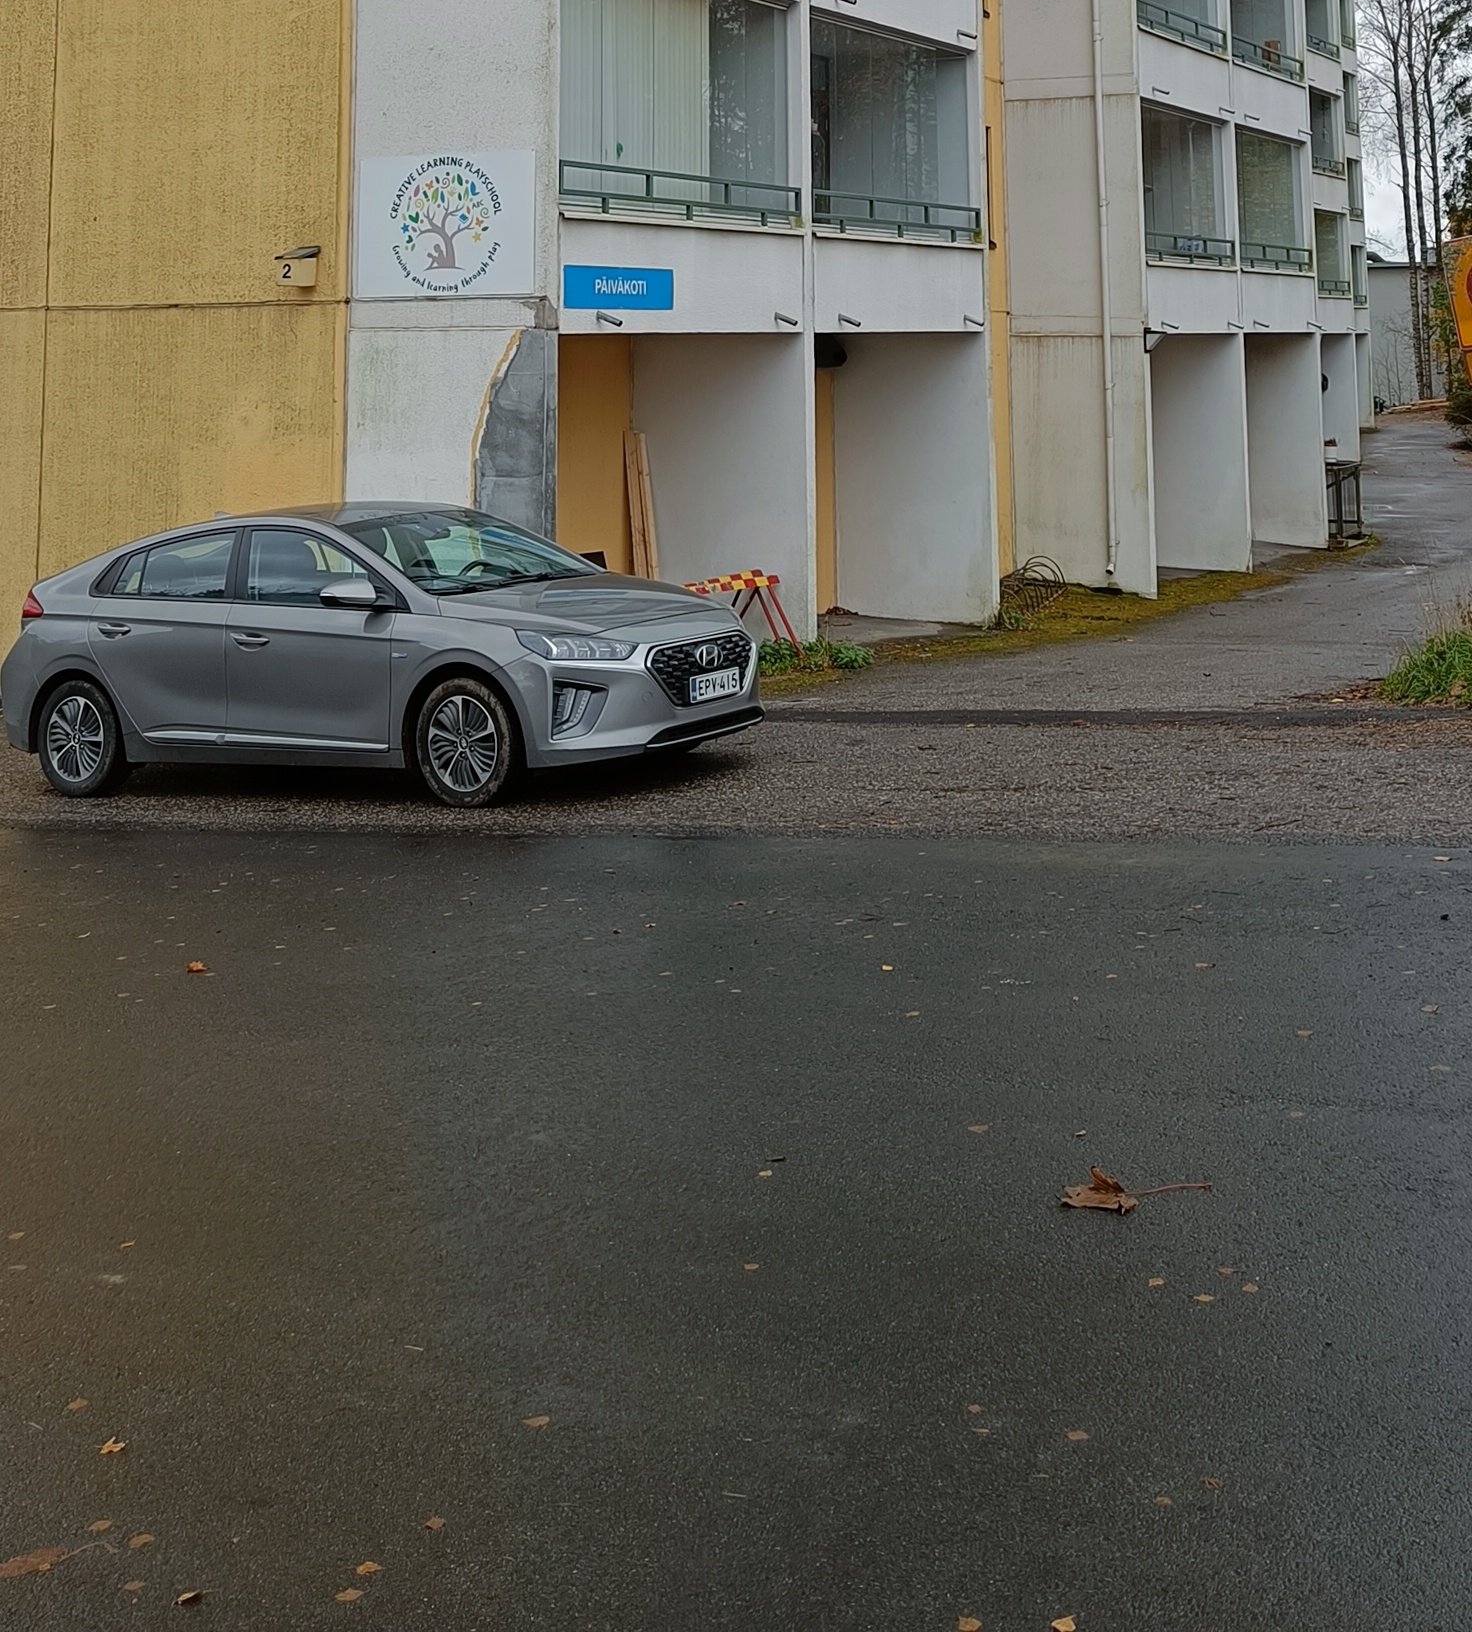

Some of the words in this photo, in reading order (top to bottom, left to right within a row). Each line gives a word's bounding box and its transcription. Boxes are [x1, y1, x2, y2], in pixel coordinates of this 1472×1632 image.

[390, 172, 417, 219] CREATIVE
[415, 156, 464, 176] LEARNING
[464, 160, 502, 215] PLAYSCHOOL
[282, 263, 292, 279] 2
[392, 244, 411, 278] Growing
[411, 276, 426, 287] and
[426, 281, 459, 293] learning
[460, 261, 490, 287] through
[487, 241, 501, 262] play
[594, 276, 647, 295] PÄIVÄKOTI
